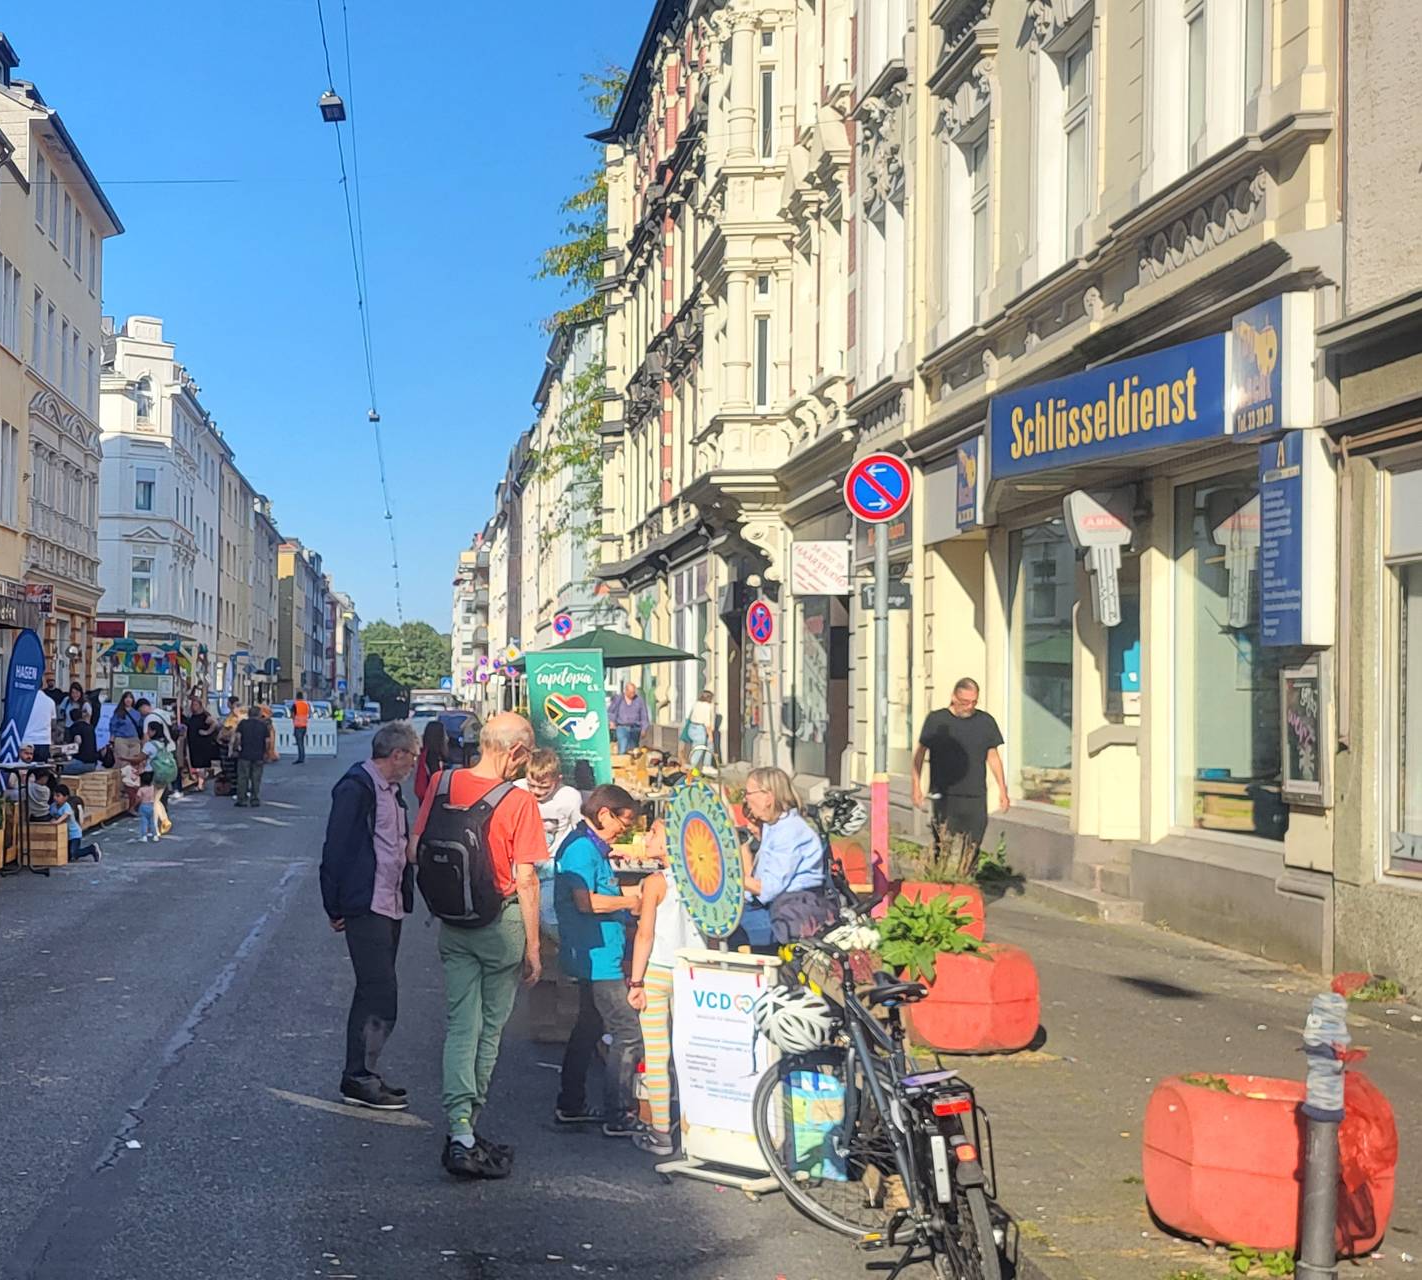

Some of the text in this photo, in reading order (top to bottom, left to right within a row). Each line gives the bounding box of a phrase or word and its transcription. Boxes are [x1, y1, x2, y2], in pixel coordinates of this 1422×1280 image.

[1010, 367, 1197, 459] Schlüsseldienst
[15, 664, 38, 680] HAGEN
[536, 667, 592, 691] capetopia
[693, 990, 731, 1010] VCD
